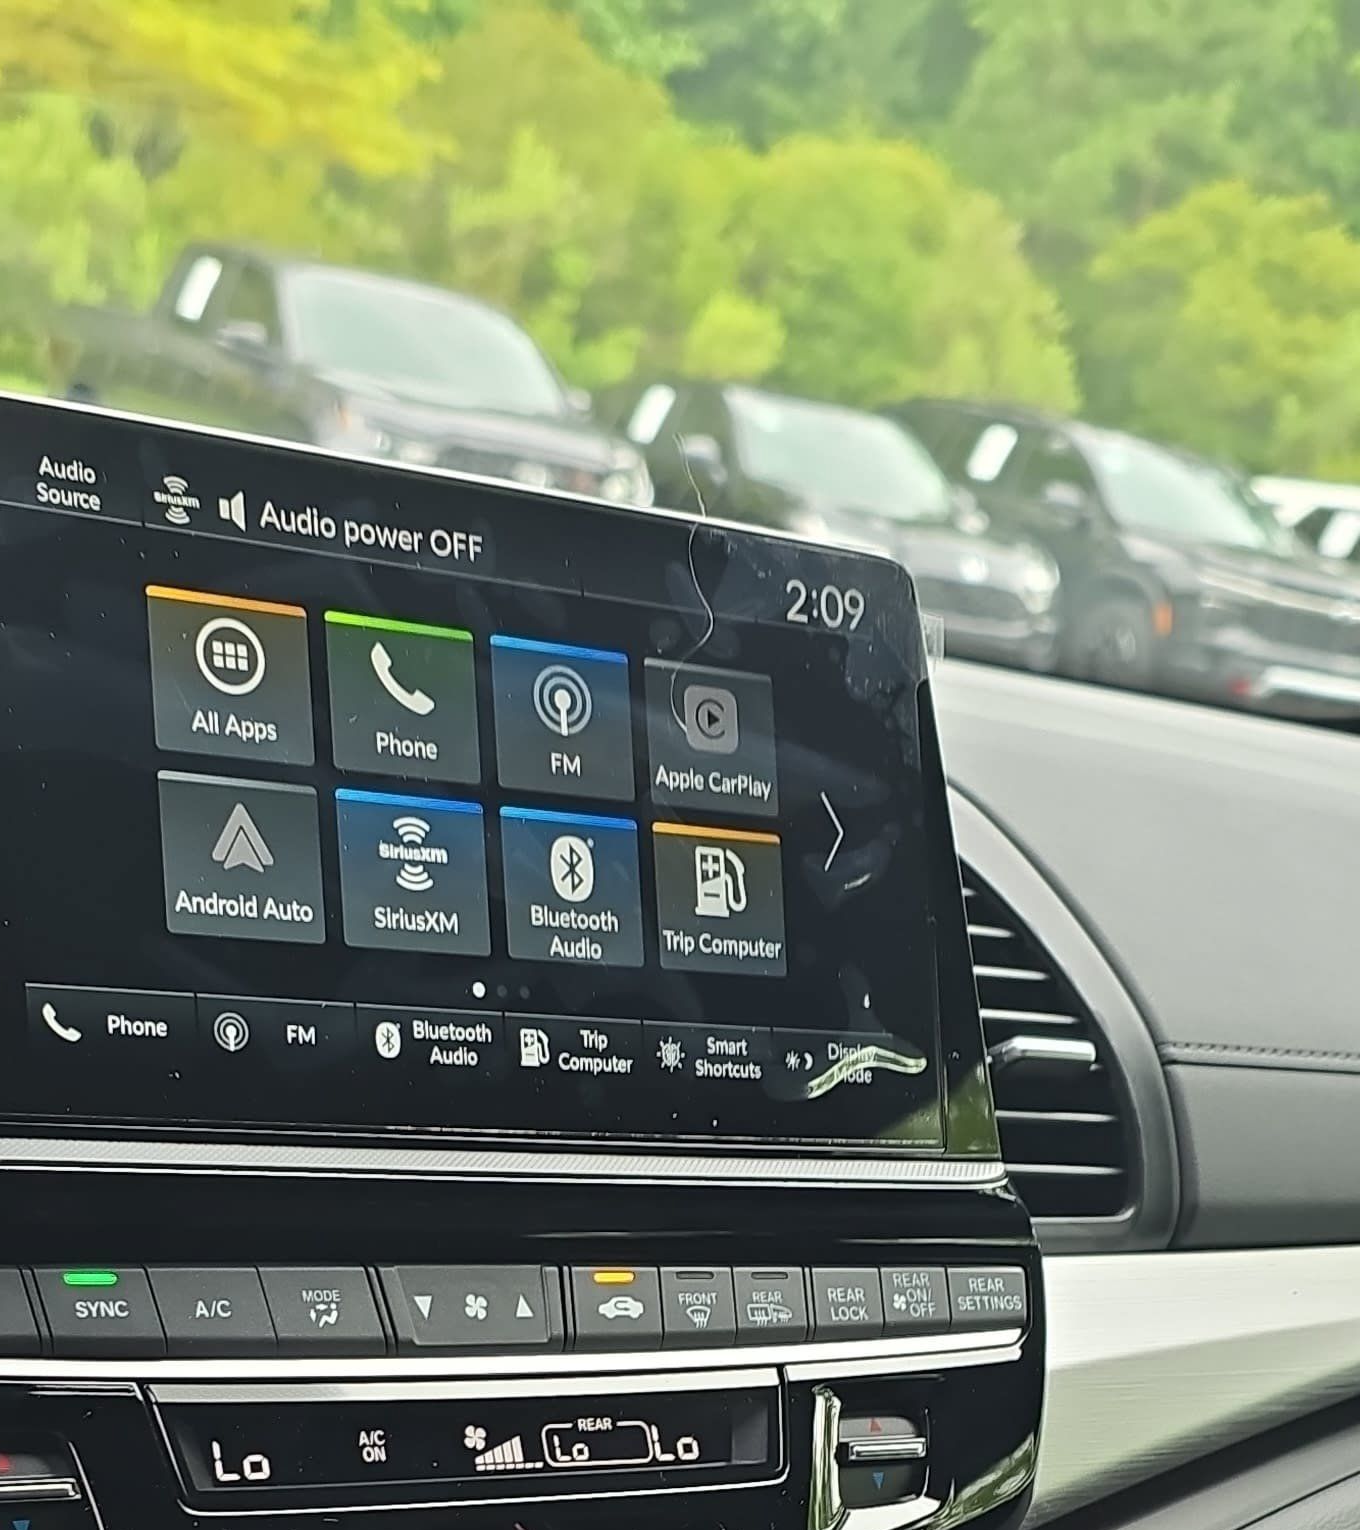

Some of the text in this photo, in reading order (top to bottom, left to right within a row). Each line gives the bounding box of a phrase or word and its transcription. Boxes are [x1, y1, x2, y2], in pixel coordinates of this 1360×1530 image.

[39, 455, 97, 484] Audio
[36, 482, 103, 512] Source
[260, 500, 483, 562] Audio power OFF
[785, 578, 866, 632] 2:09
[191, 709, 278, 744] All Apps
[375, 731, 438, 762] Phone
[551, 753, 581, 777] FM
[655, 768, 772, 802] Apple CarPlay
[175, 890, 314, 924] Android Auto
[373, 906, 459, 936] SiriusXM
[530, 905, 619, 934] Bluetooth
[550, 937, 602, 962] Audio
[662, 929, 782, 962] Trip Computer
[107, 1014, 168, 1039] Phone
[286, 1024, 317, 1046] FM
[412, 1019, 493, 1046] Bluetooth
[580, 1028, 608, 1052] Trip
[706, 1036, 748, 1058] Smart
[429, 1045, 479, 1068] Audio
[558, 1052, 634, 1076] Computer
[695, 1058, 763, 1081] Shortcuts
[891, 1272, 930, 1288] REAR
[968, 1277, 1005, 1294] REAR
[302, 1289, 341, 1304] MODE
[677, 1291, 718, 1307] FRONT
[751, 1290, 783, 1304] REAR
[827, 1287, 866, 1303] REAR
[906, 1287, 933, 1302] ON/
[957, 1295, 1023, 1312] SETTINGS
[75, 1300, 129, 1319] SYNC
[195, 1299, 232, 1319] A/C
[830, 1303, 869, 1322] LOCK
[908, 1301, 937, 1317] OFF
[577, 1417, 613, 1432] REAR
[358, 1429, 385, 1447] A/C
[552, 1434, 590, 1462] Lo
[651, 1423, 700, 1462] Lo
[213, 1439, 271, 1482] Lo
[361, 1445, 387, 1463] ON
